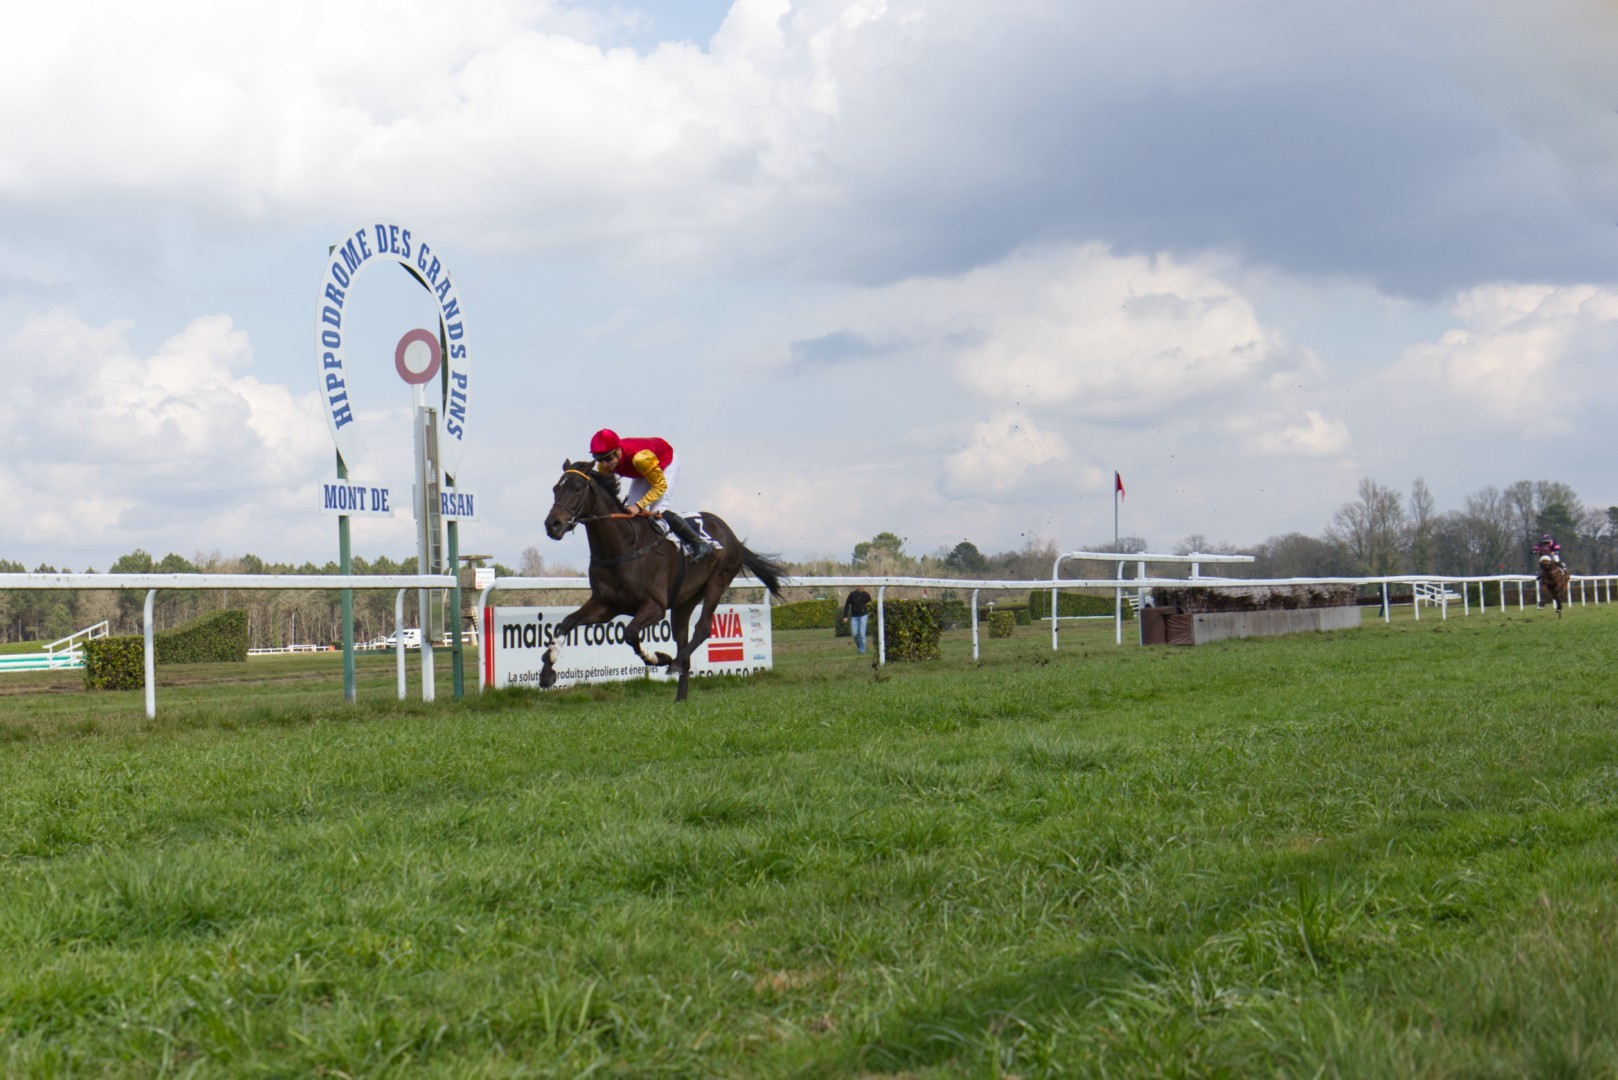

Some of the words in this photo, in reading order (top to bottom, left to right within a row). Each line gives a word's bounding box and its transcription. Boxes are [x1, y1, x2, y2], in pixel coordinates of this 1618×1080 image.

[321, 228, 373, 430] HIPPODROME
[374, 224, 412, 260] DES
[416, 242, 467, 360] GRANDS
[446, 369, 468, 441] PINS
[323, 484, 366, 511] MONT
[370, 487, 390, 512] DE
[440, 491, 474, 517] RSAN
[709, 607, 743, 639] AVIA
[508, 671, 518, 683] La
[519, 669, 541, 682] soluti
[557, 667, 583, 680] roduits
[584, 664, 620, 681] pétroliers
[620, 665, 628, 676] et
[628, 663, 659, 674] éneries
